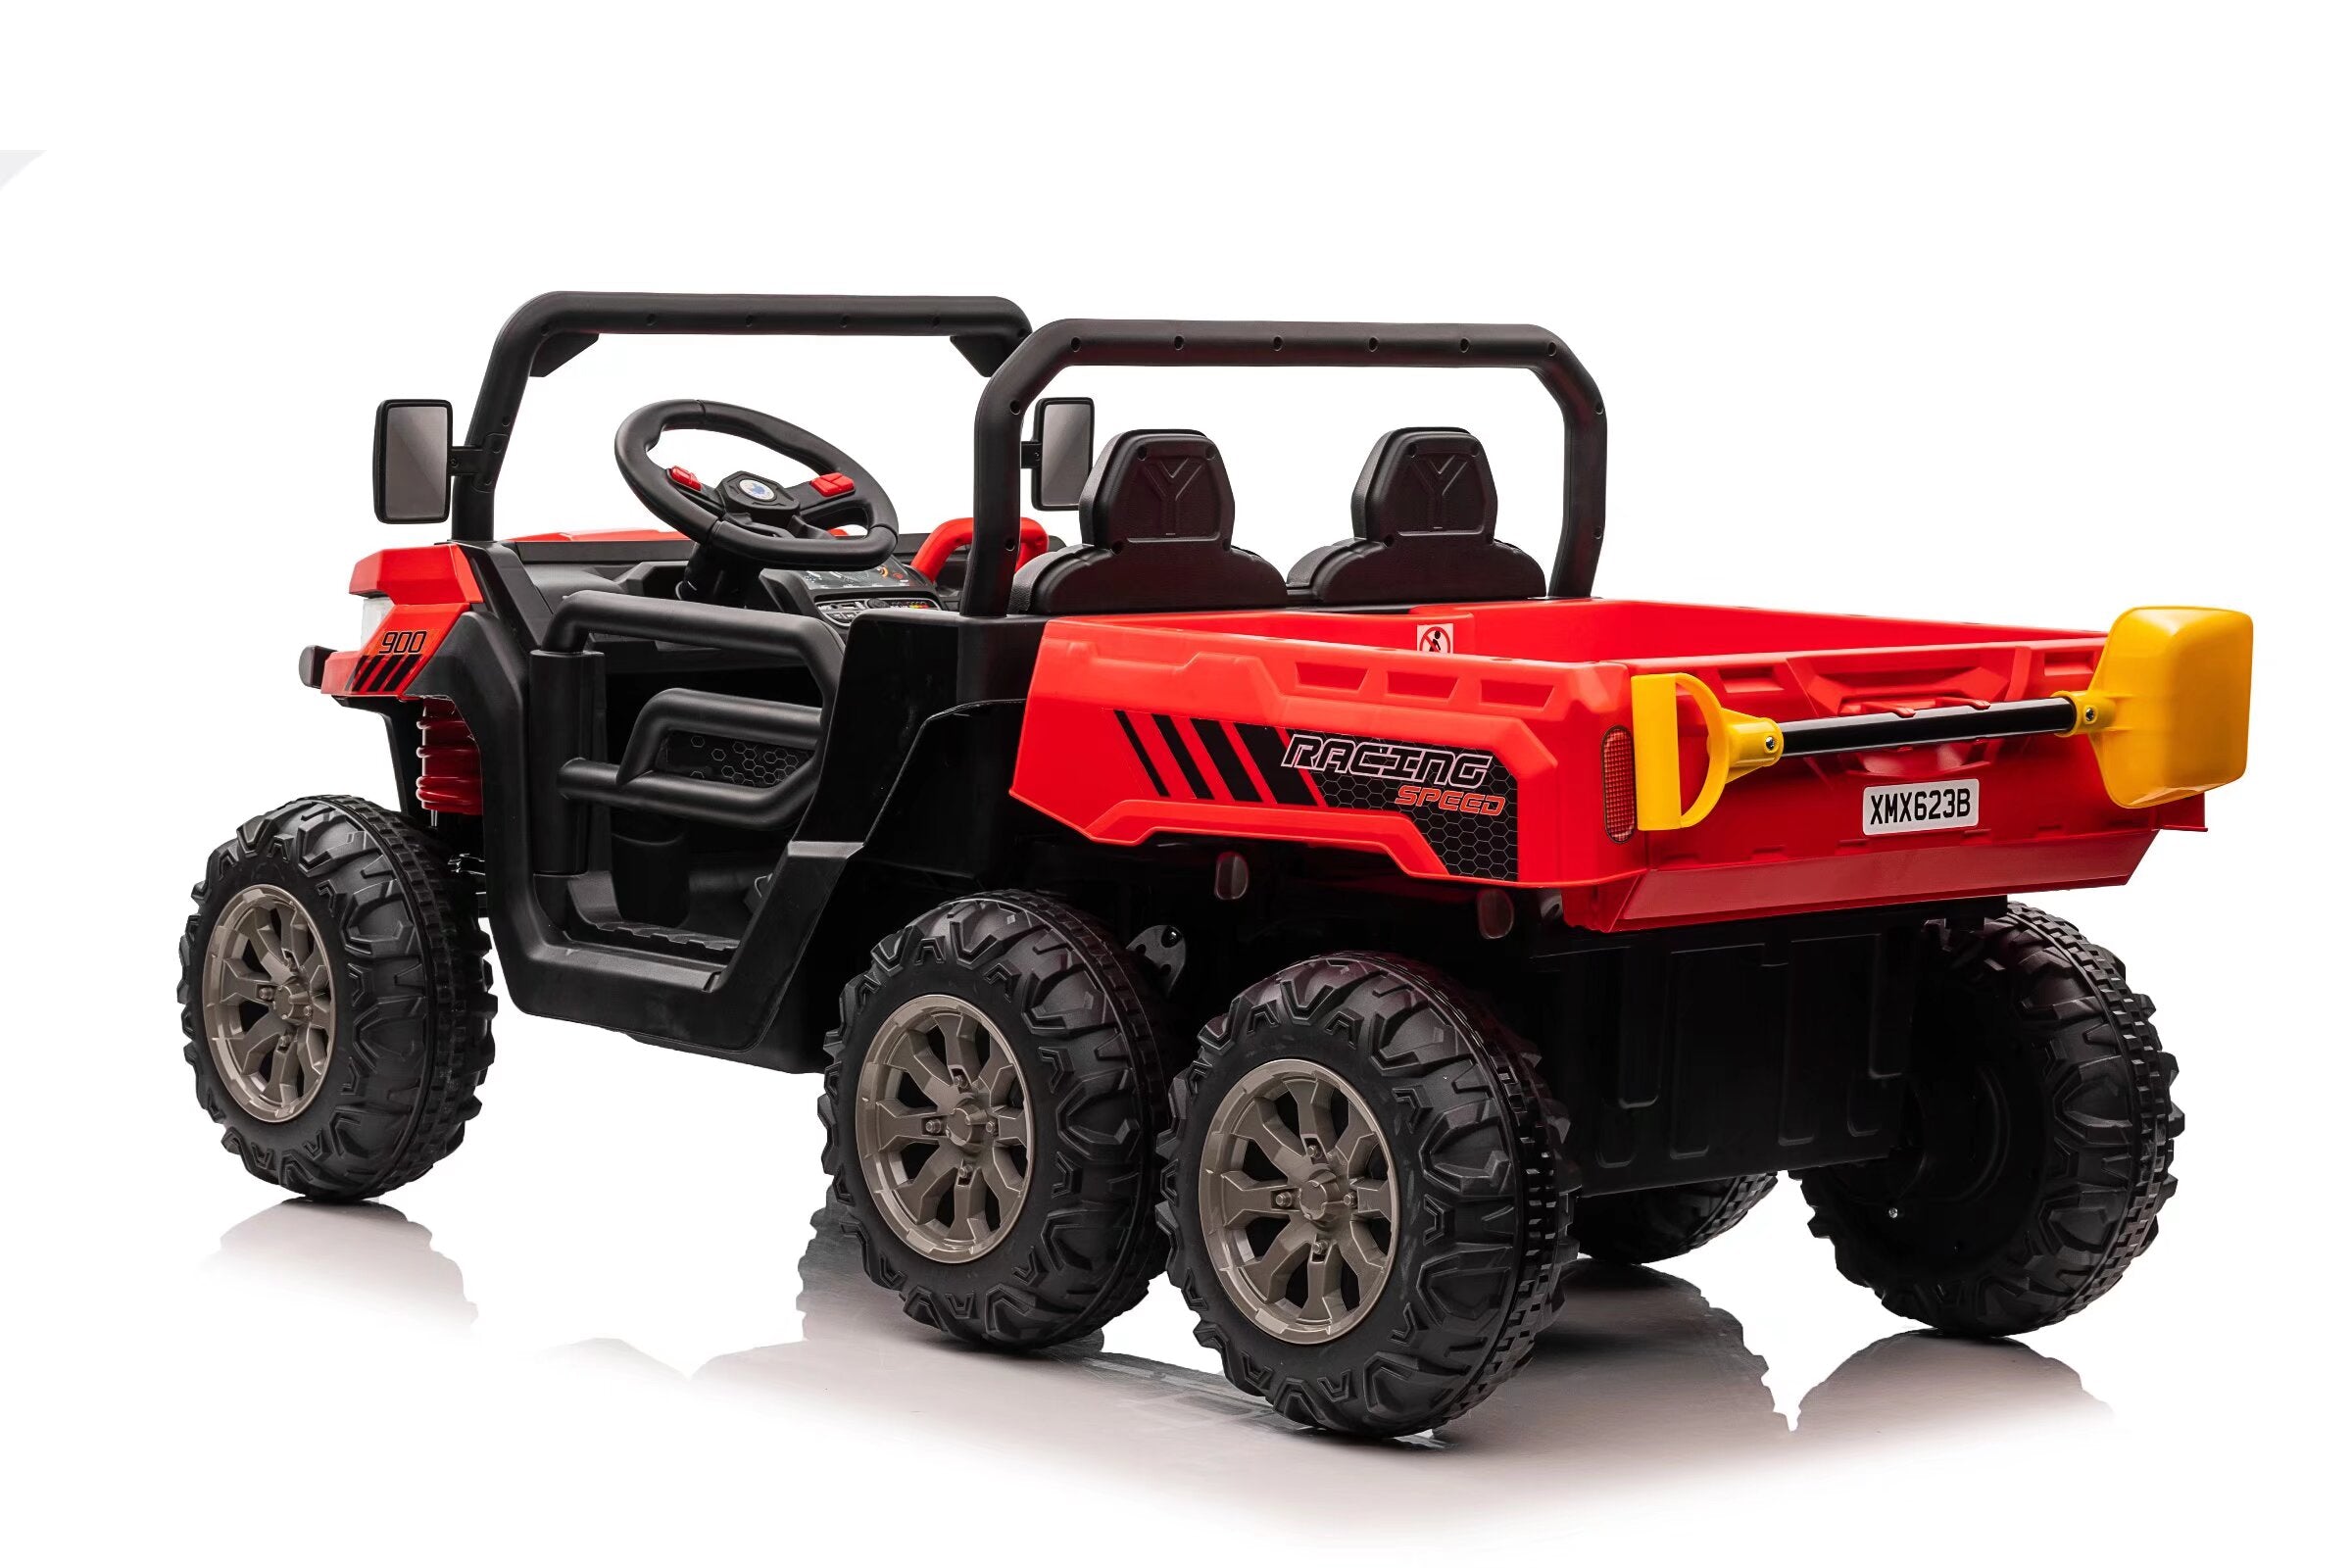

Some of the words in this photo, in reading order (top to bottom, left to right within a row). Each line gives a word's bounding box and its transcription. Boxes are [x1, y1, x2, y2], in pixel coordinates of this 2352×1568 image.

[378, 630, 427, 655] 900
[1280, 733, 1494, 789] RACING
[1395, 785, 1506, 816] SPEED
[1870, 788, 1971, 825] XMX623B
